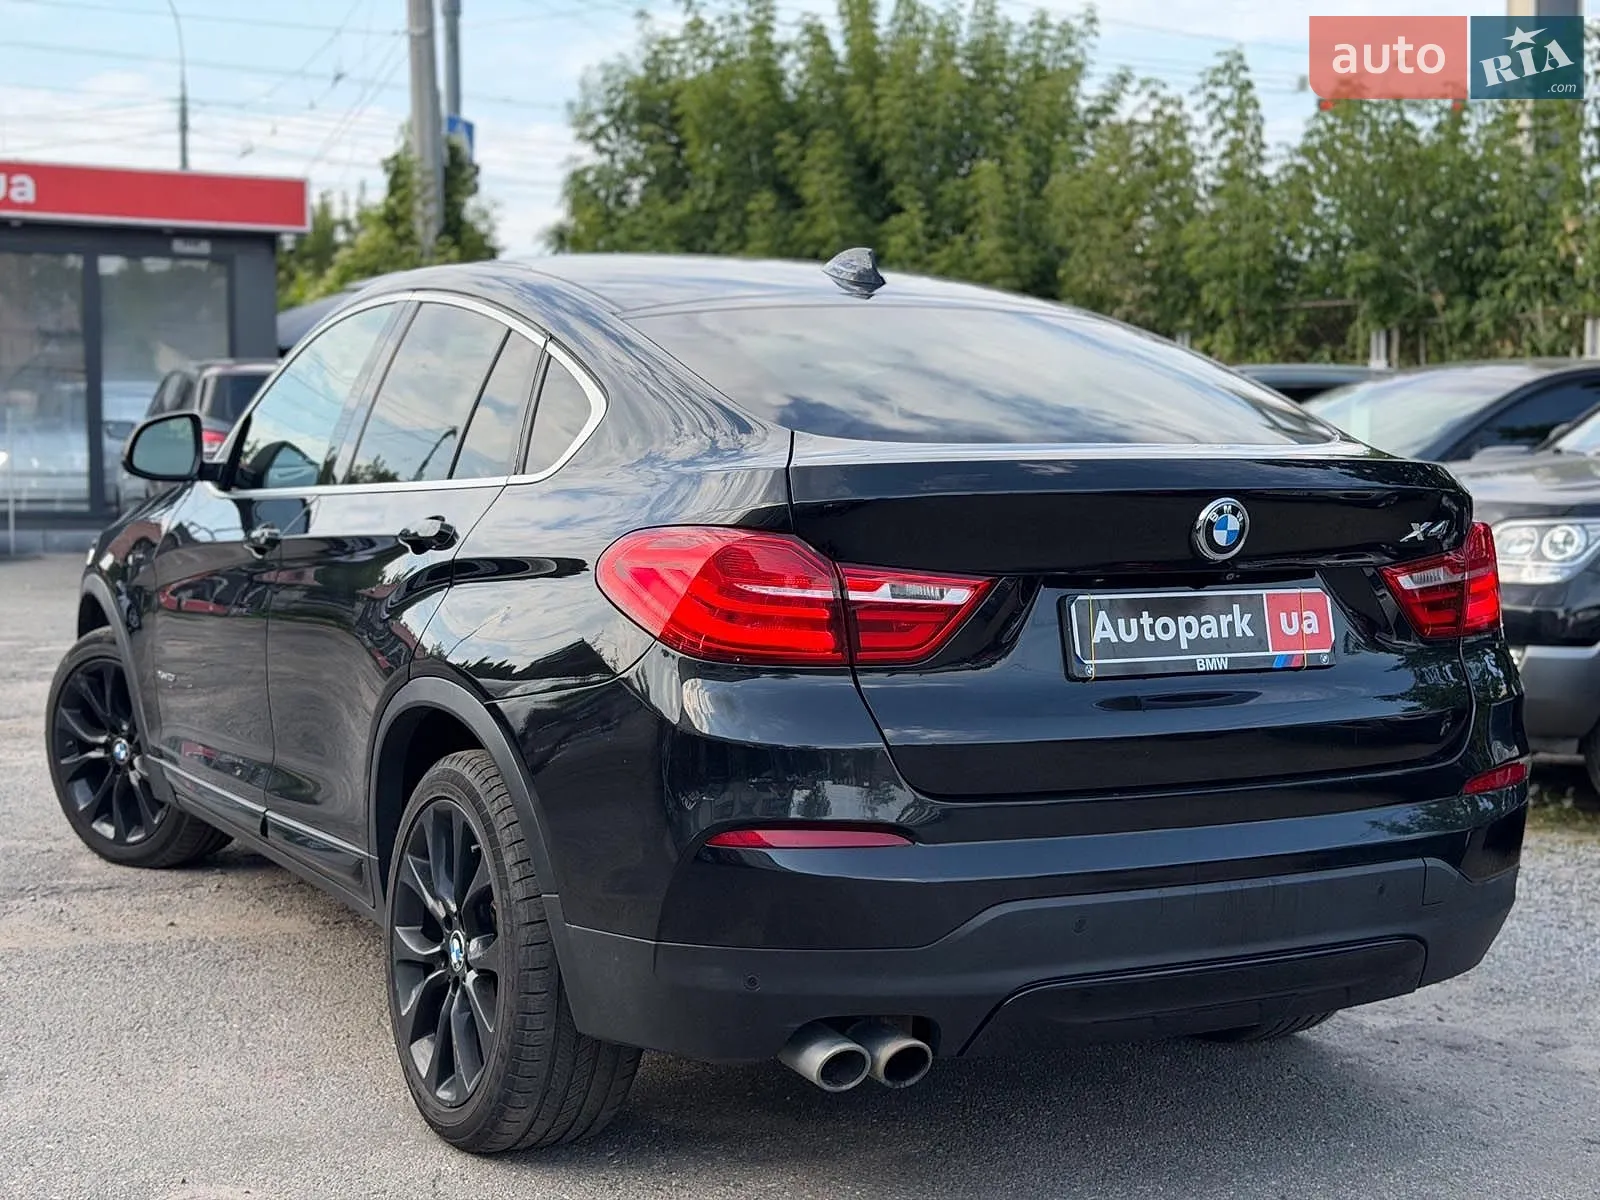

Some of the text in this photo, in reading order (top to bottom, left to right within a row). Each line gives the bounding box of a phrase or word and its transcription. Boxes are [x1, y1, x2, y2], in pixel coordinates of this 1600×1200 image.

[0, 172, 36, 204] a
[1209, 505, 1244, 523] BMW
[1400, 519, 1450, 543] X4
[1093, 603, 1319, 650] Autopark ua
[1196, 657, 1229, 671] BMW
